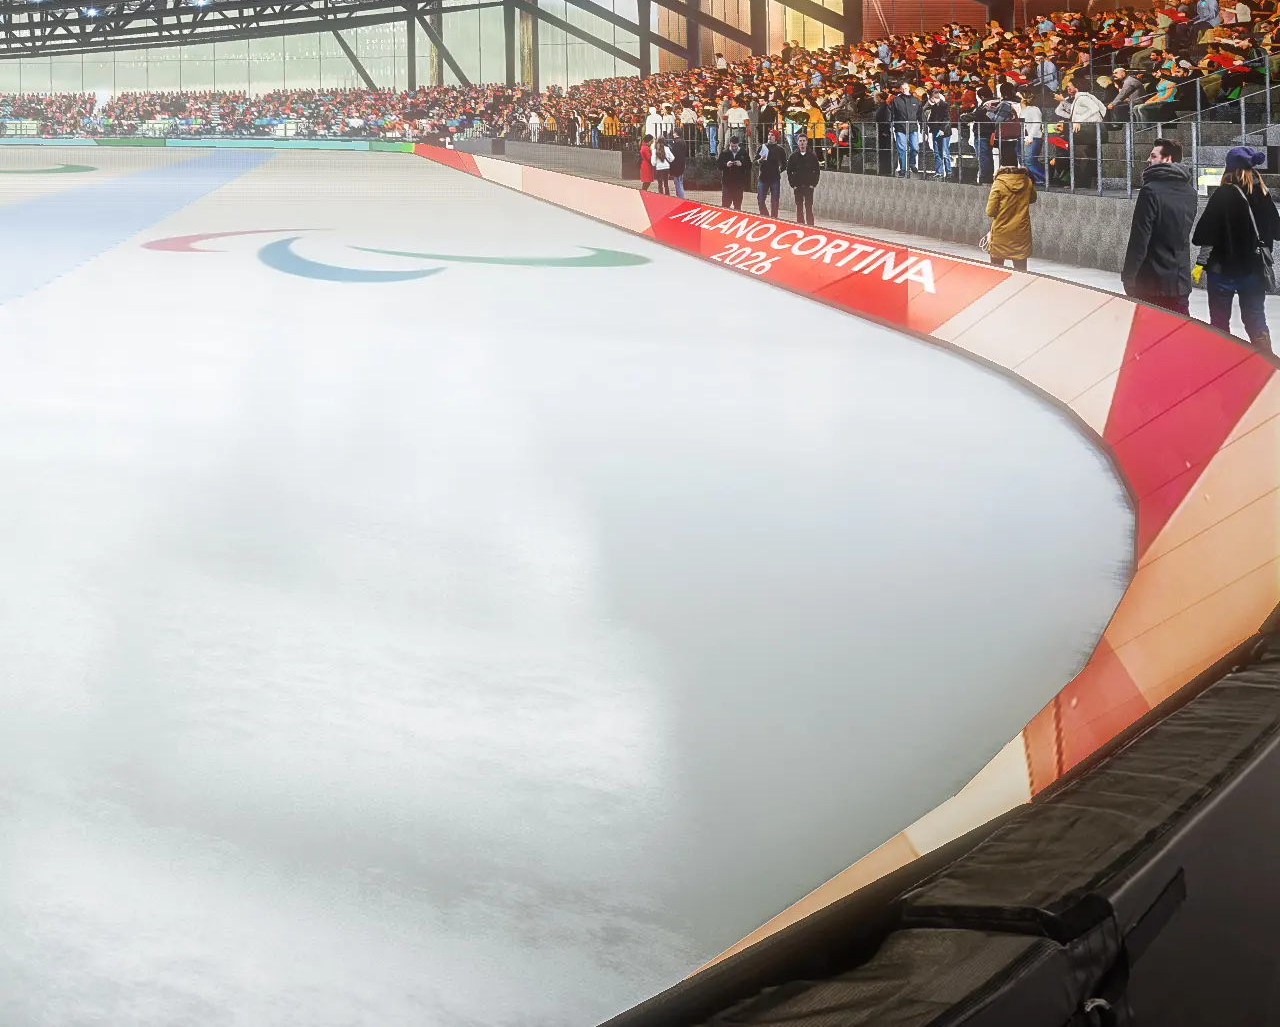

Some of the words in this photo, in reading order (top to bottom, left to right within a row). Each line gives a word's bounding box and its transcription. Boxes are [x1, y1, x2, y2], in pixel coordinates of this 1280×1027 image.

[669, 205, 778, 243] MILANO
[769, 228, 937, 294] CORTINA
[709, 242, 782, 275] 2026
